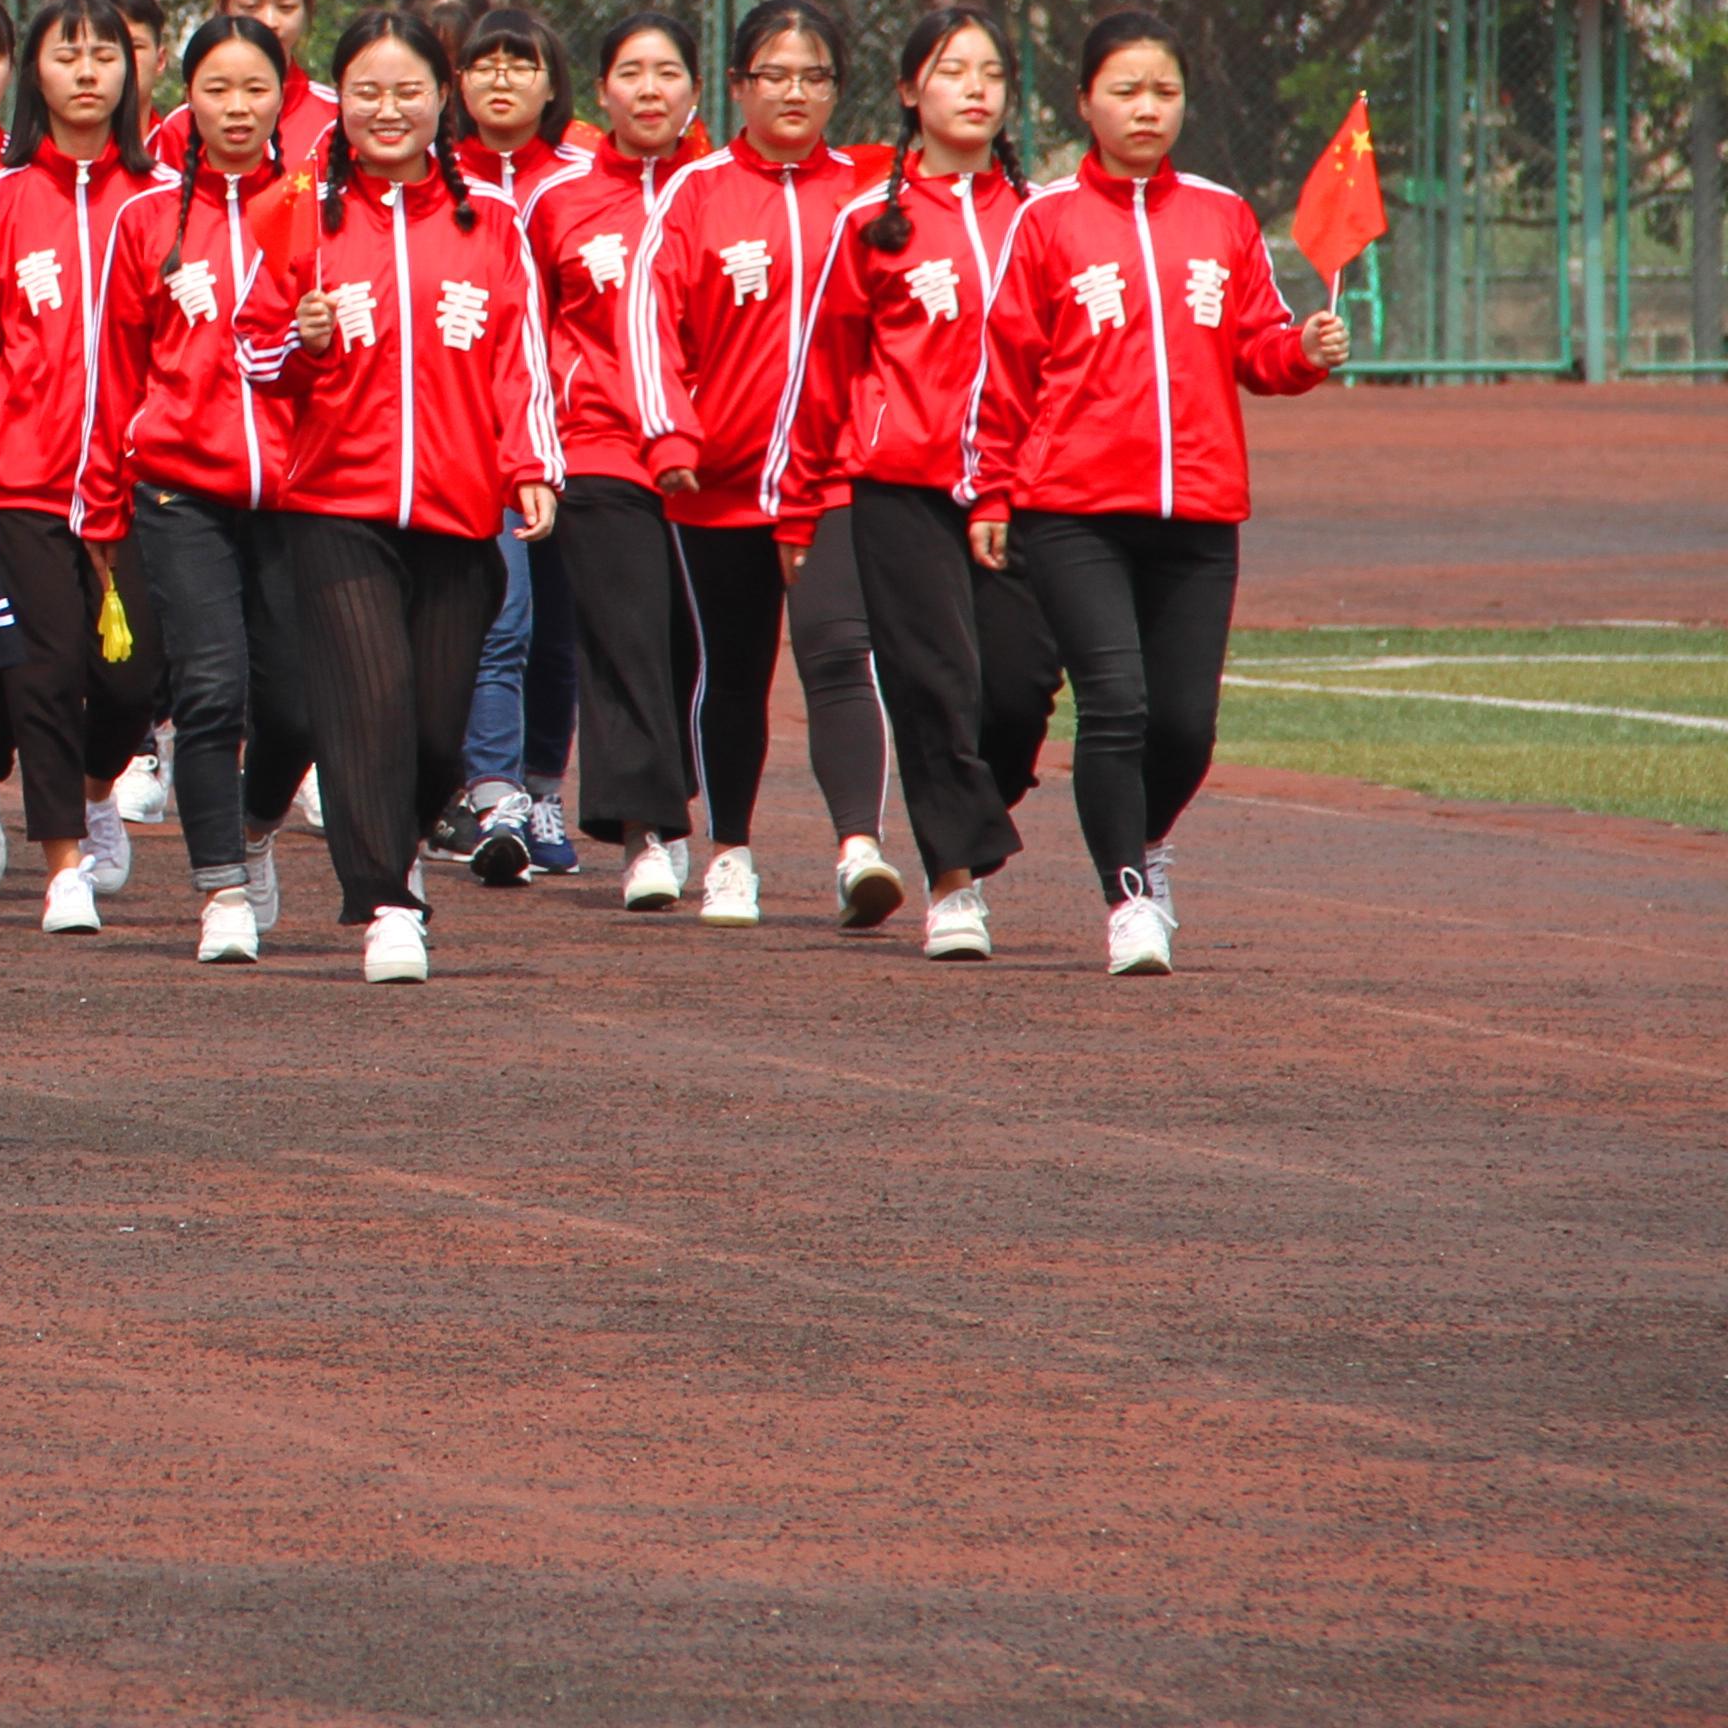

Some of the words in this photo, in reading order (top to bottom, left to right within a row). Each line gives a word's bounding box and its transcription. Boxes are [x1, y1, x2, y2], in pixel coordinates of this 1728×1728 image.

[15, 248, 63, 317] 青
[163, 260, 218, 329] 青
[578, 233, 628, 294] 青
[719, 240, 773, 306] 青
[904, 258, 960, 325] 青
[1070, 261, 1127, 336] 青
[1185, 258, 1230, 328] 春
[330, 280, 377, 354] 青
[435, 280, 490, 351] 春
